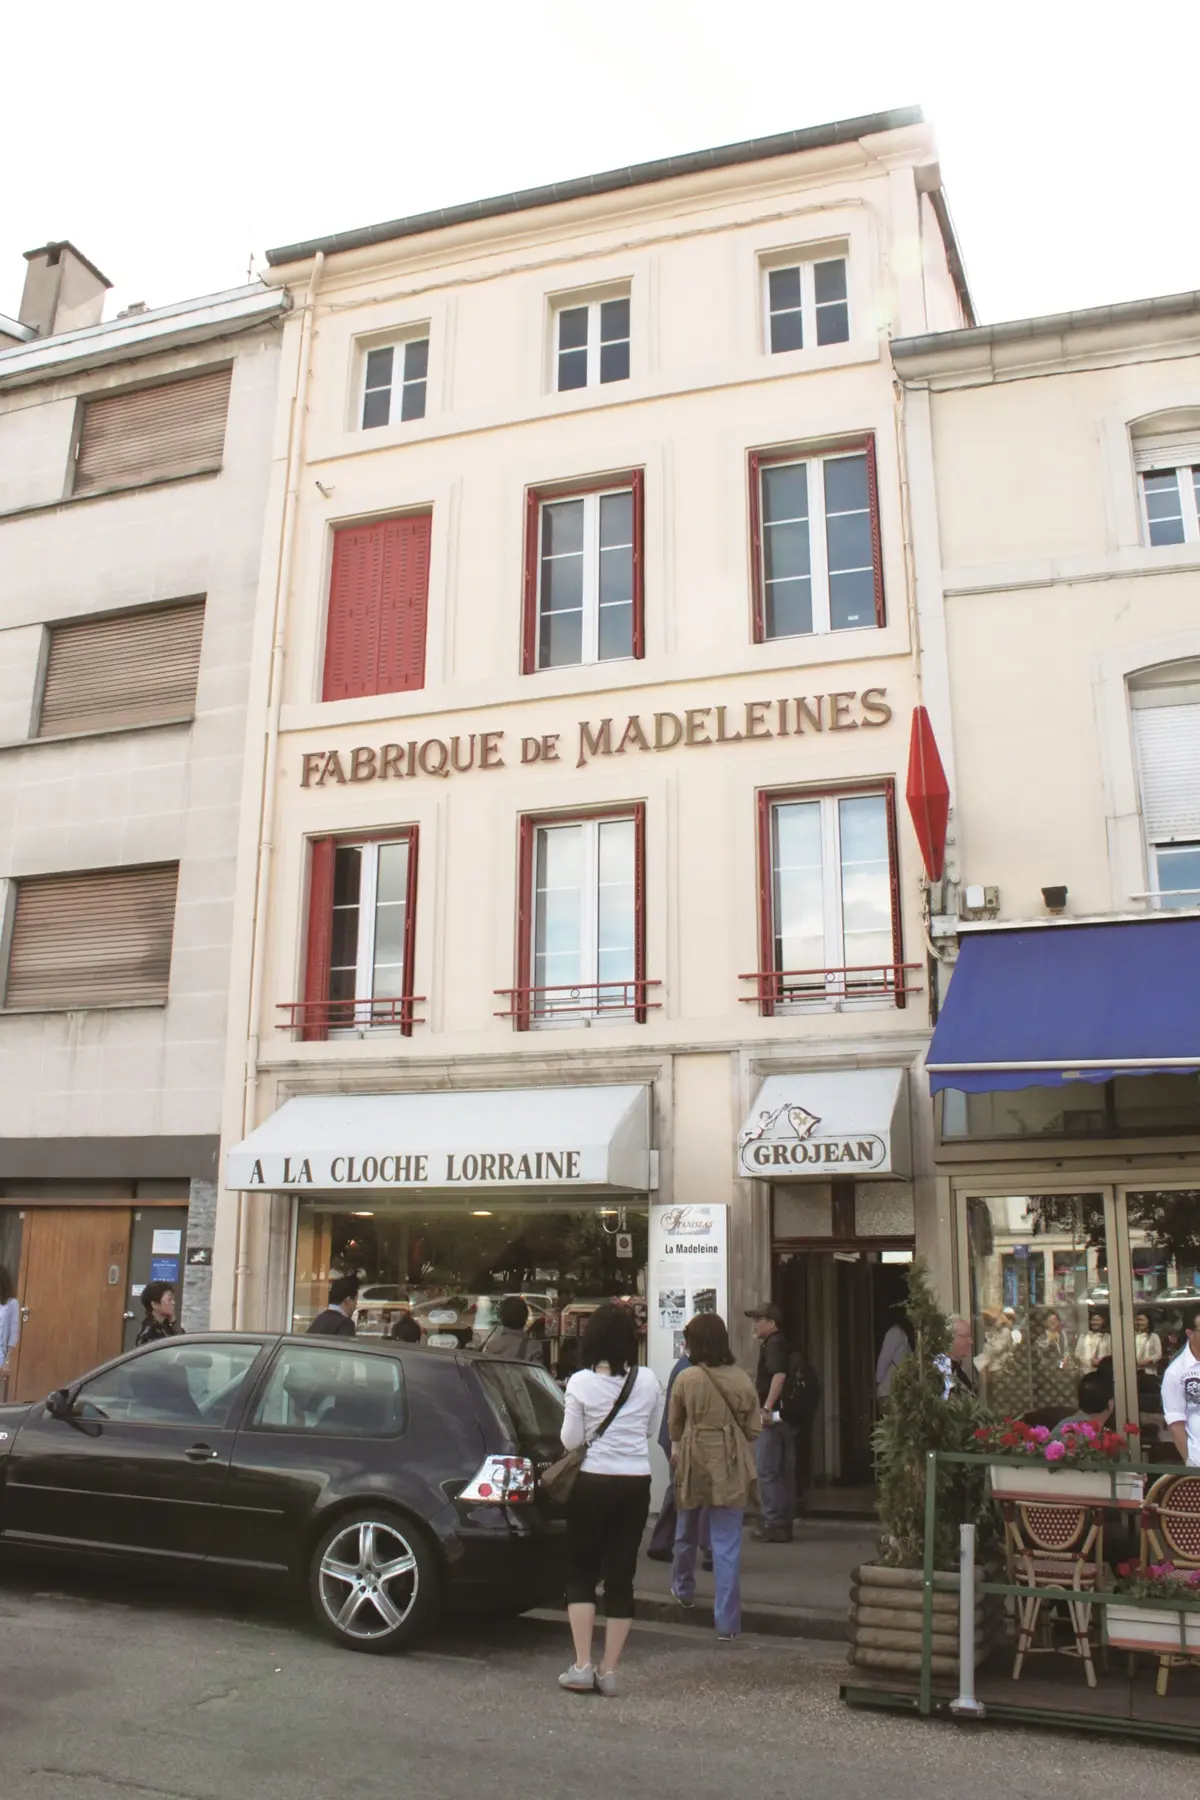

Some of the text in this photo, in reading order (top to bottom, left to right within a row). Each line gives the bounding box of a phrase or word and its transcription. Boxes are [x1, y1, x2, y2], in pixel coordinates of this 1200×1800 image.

[300, 687, 893, 788] FABRIQUE DE MADELEINES
[753, 1141, 875, 1165] GROJEAN
[249, 1151, 580, 1184] A LA CLOCHE LORRAINE
[665, 1243, 719, 1254] La Madeleine
